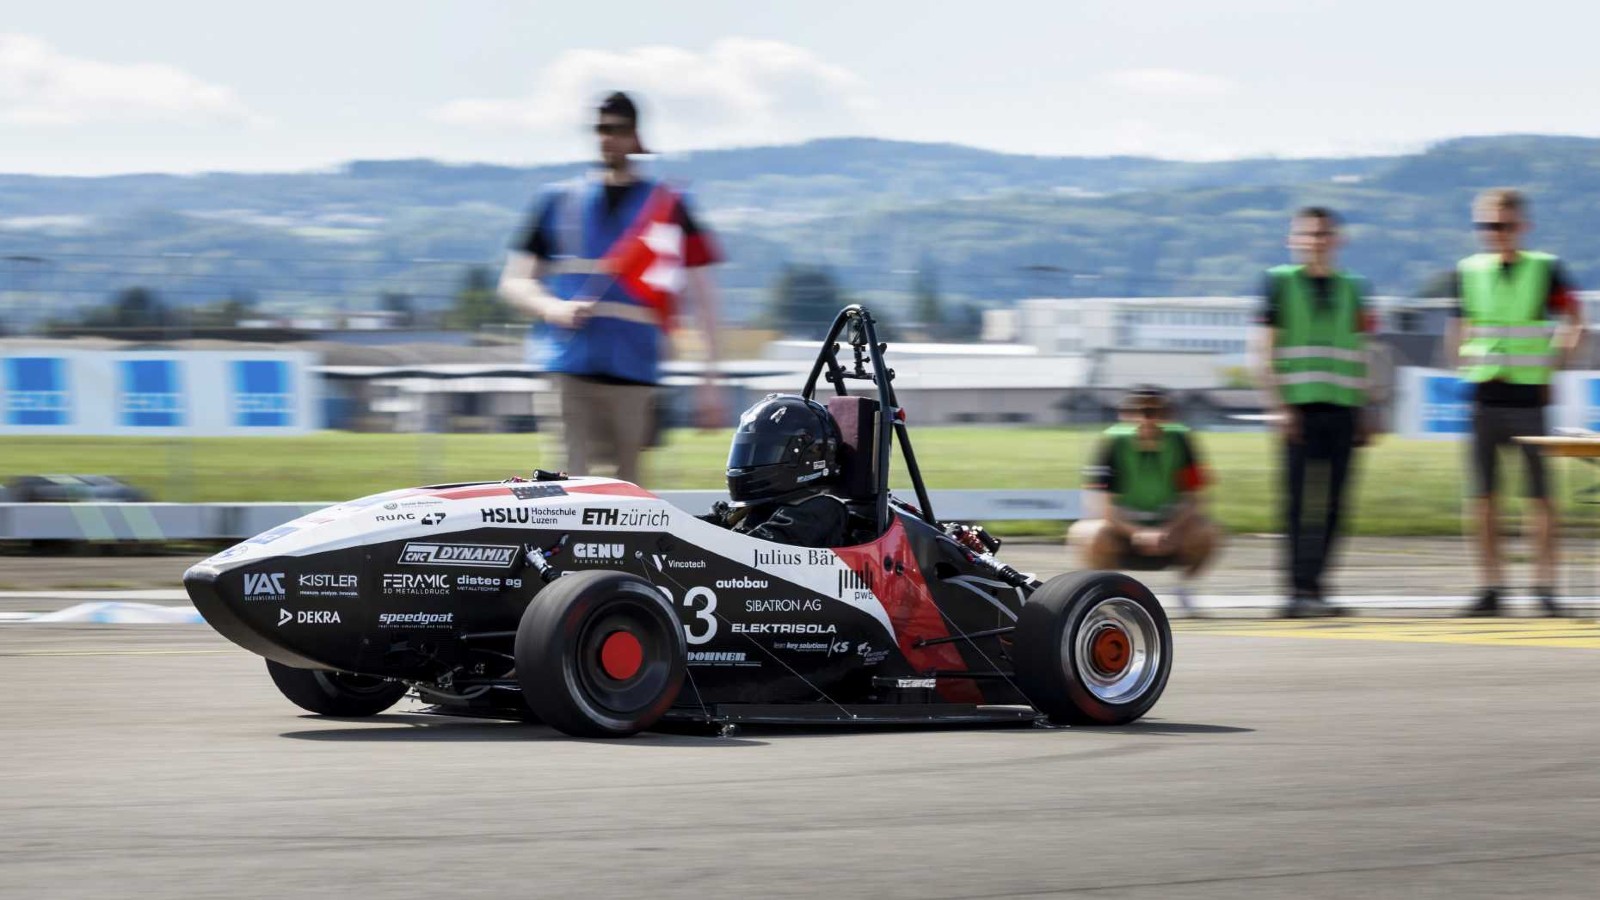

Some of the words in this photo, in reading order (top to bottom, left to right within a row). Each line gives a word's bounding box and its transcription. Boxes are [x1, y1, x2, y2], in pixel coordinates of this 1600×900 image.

[376, 513, 416, 522] RUAG
[481, 507, 529, 524] HSLU
[531, 507, 577, 516] Hochschule
[531, 516, 558, 525] Luzern
[404, 552, 426, 562] CNC
[438, 546, 514, 562] DYNAMIX
[573, 543, 625, 559] GENU
[668, 559, 707, 569] Vincotech
[753, 549, 802, 568] Julius
[808, 549, 839, 565] Bär
[243, 572, 286, 595] VAC
[299, 574, 358, 587] KISTLER
[383, 574, 450, 589] FERAMIC
[456, 574, 501, 586] distec
[505, 578, 522, 588] ag
[716, 577, 768, 589] autobau
[395, 588, 450, 596] METALLDRUCK
[855, 590, 874, 601] pwb
[745, 599, 800, 612] SIBATRON
[803, 599, 822, 612] AG
[297, 611, 341, 624] DEKRA
[379, 611, 454, 625] speedgoat
[731, 623, 837, 634] ELEKTRISOLA
